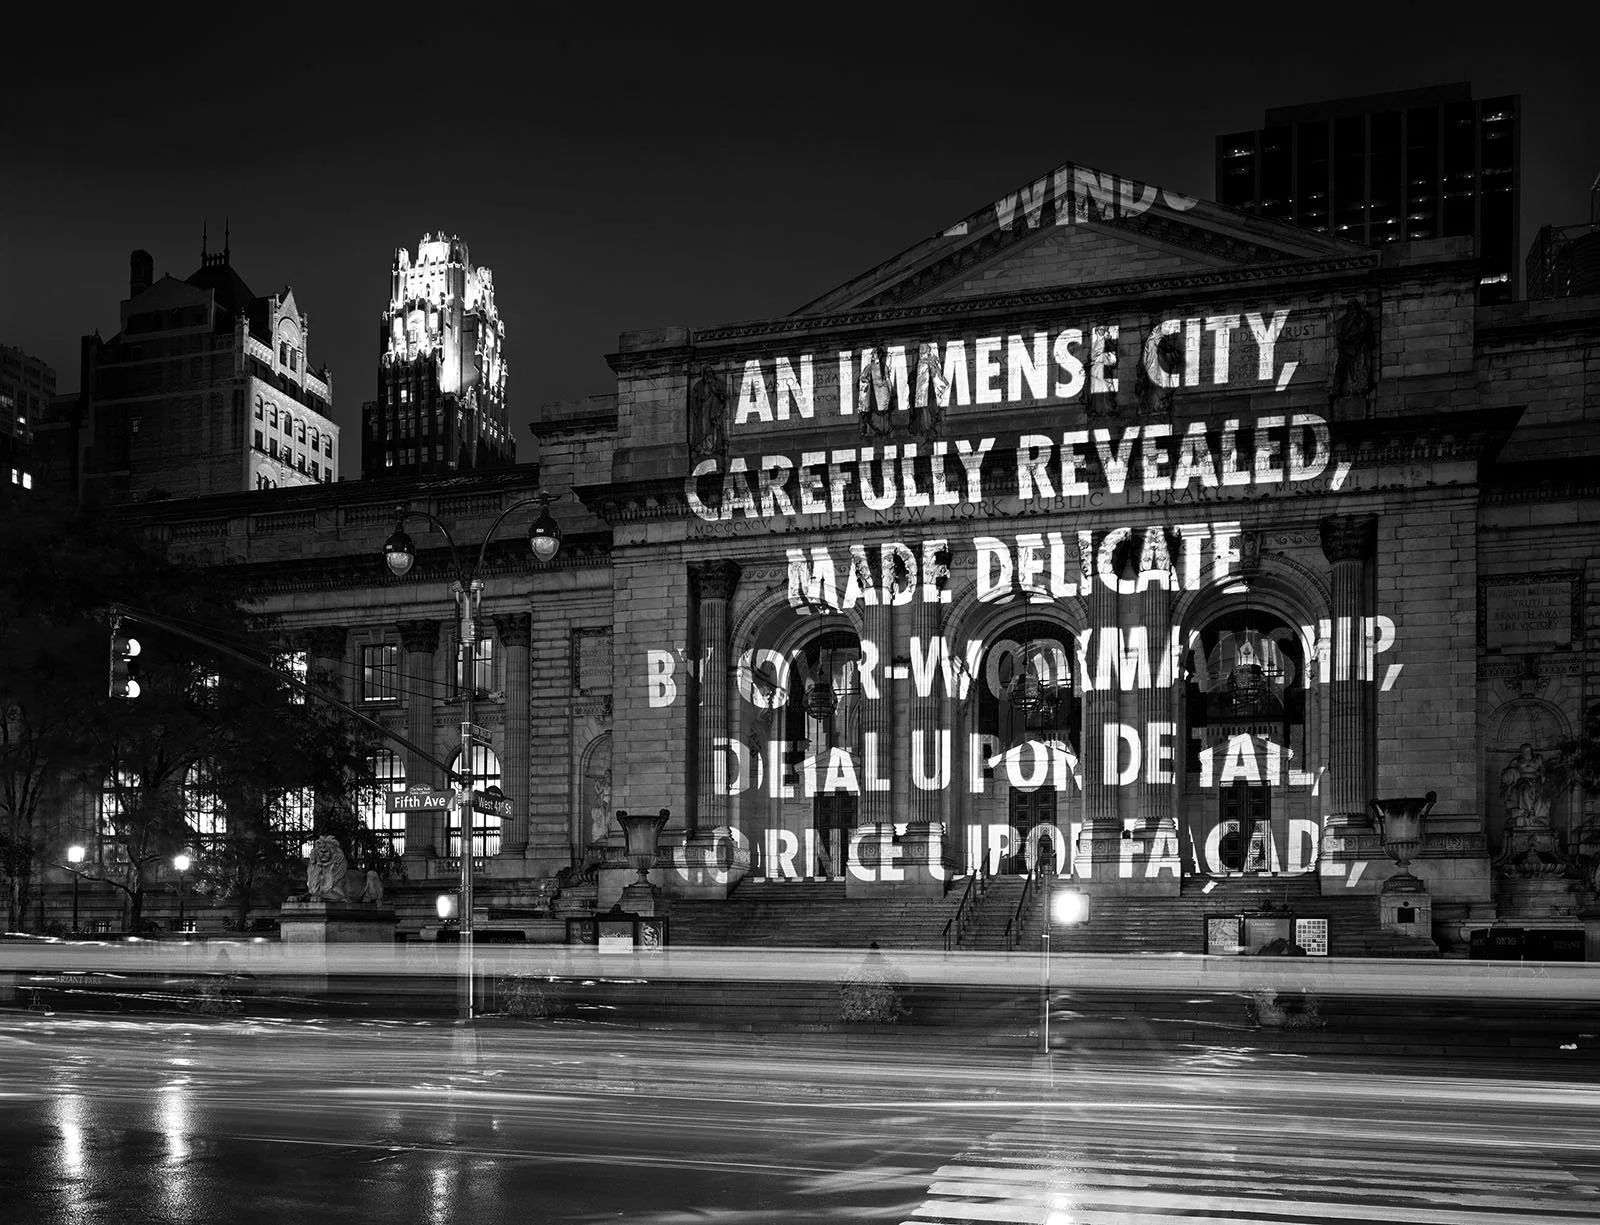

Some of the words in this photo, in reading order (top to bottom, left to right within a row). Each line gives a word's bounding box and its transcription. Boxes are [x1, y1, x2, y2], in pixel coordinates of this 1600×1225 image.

[734, 354, 814, 424] AN
[838, 325, 1120, 415] IMMENSE
[1143, 309, 1299, 392] CITY,
[684, 439, 995, 521] CAREFULLY
[1017, 413, 1352, 499] REVEALED,
[814, 510, 856, 527] THE
[874, 505, 928, 521] NEW
[947, 499, 1002, 517] YORK
[1023, 491, 1104, 512] PUBLIC
[1126, 483, 1226, 505] LIBRARY
[786, 539, 953, 615] MADE
[973, 521, 1250, 604] DELICATE
[394, 795, 420, 808] Fifth
[424, 795, 446, 807] Ave
[478, 796, 493, 810] West
[505, 803, 512, 815] St
